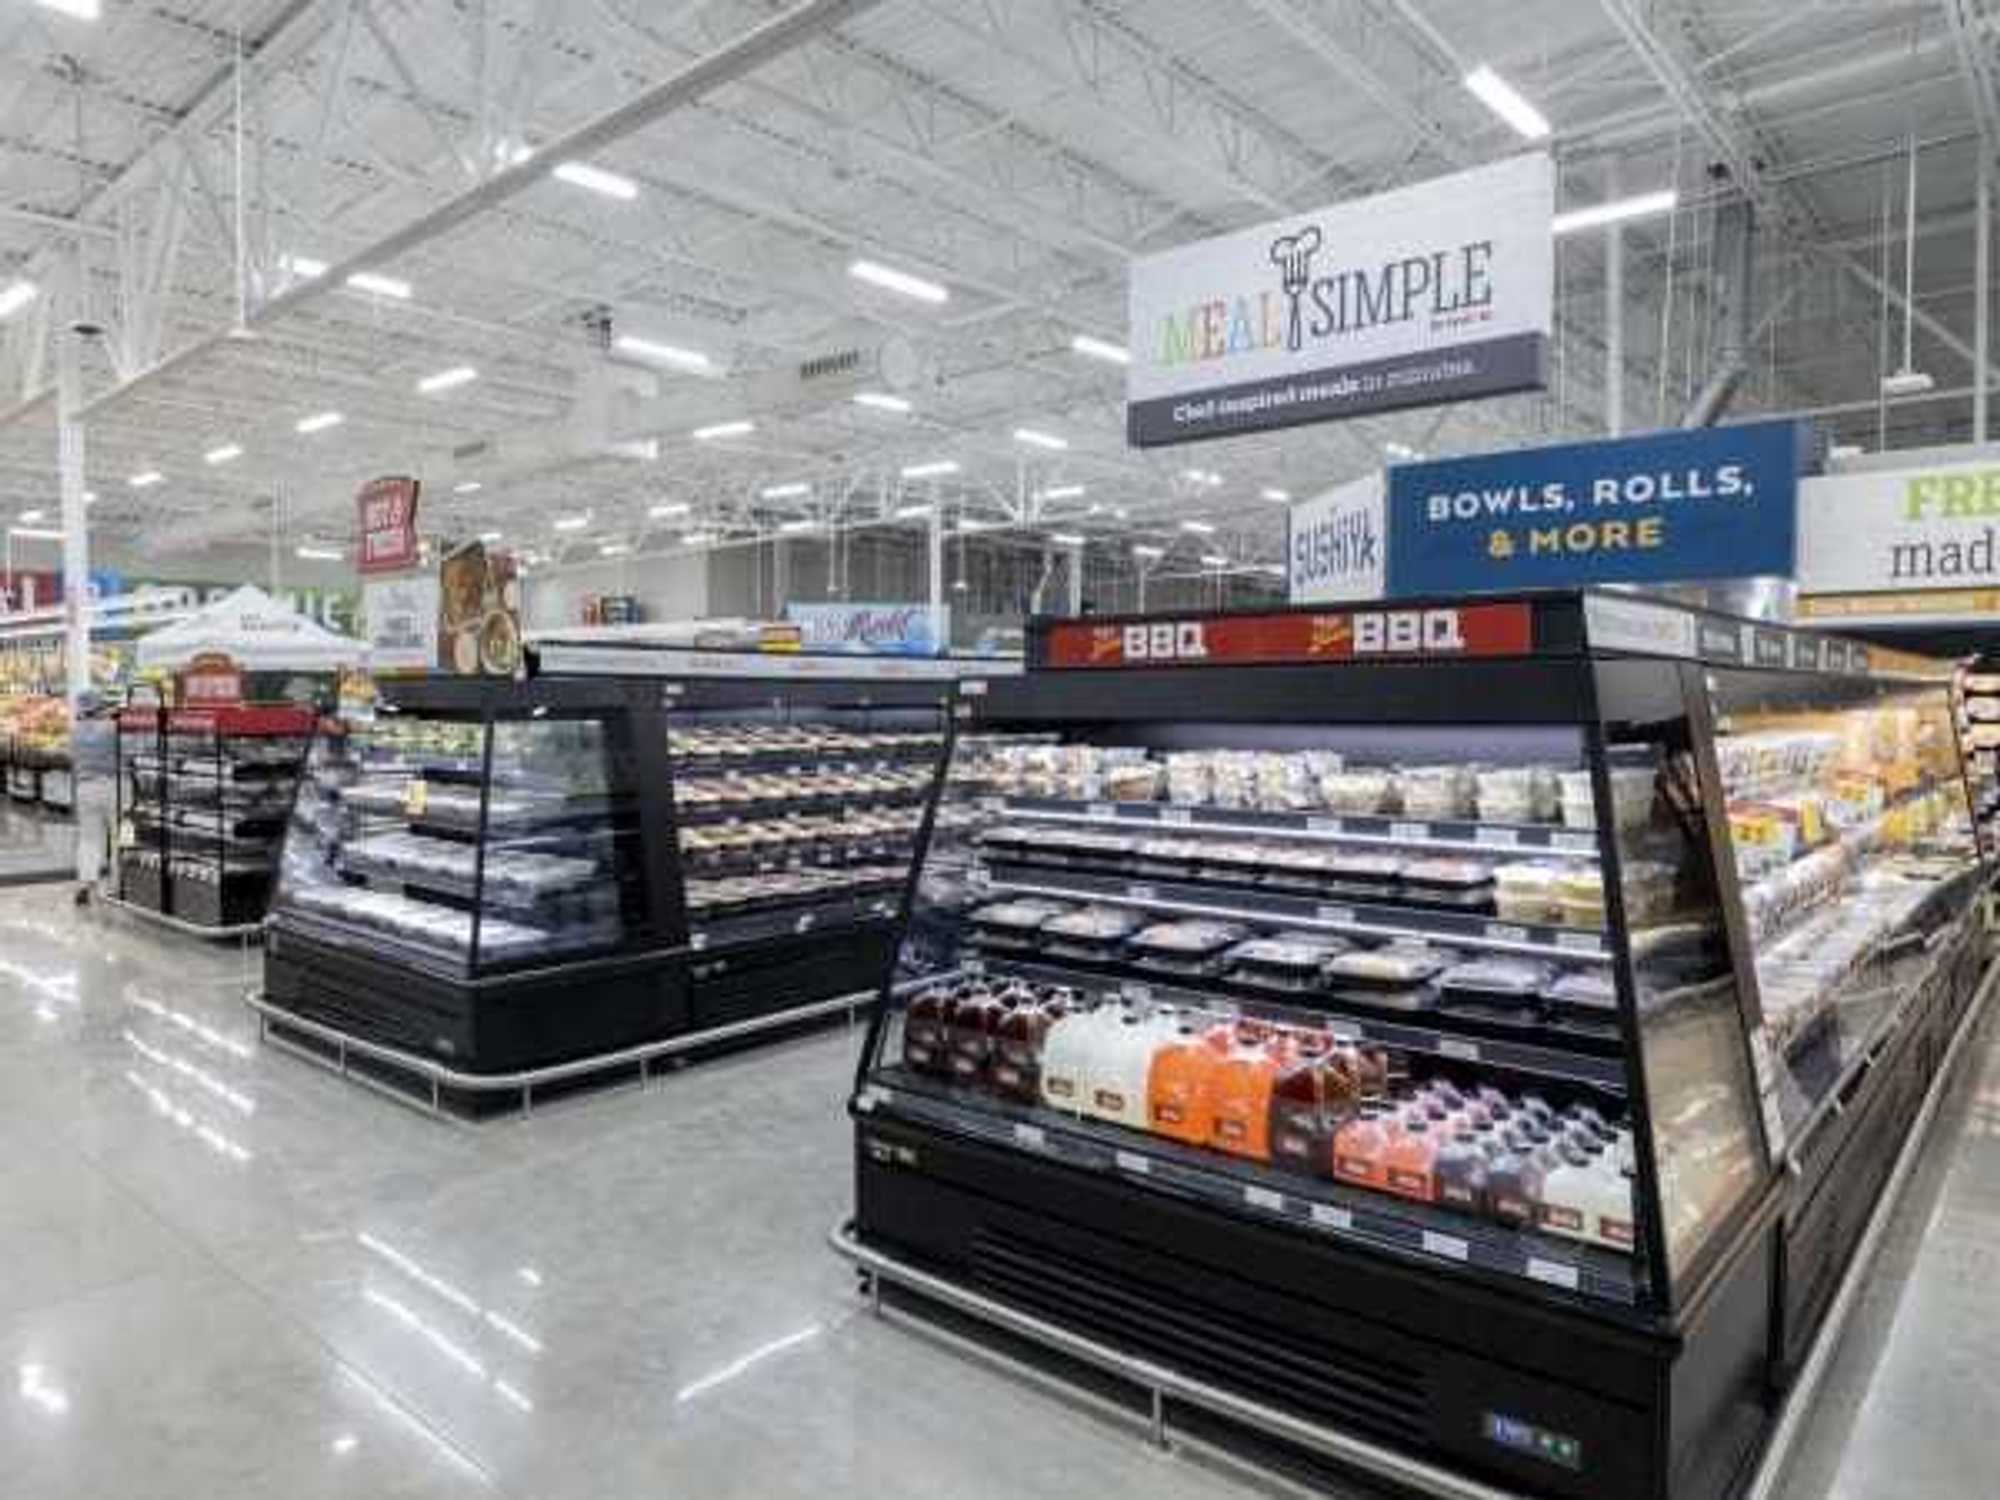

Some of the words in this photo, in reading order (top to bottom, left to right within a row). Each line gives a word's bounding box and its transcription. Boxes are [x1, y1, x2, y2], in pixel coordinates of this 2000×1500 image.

[1159, 290, 1281, 366] MEAL
[1310, 240, 1492, 338] SIMPLE
[1428, 483, 1575, 522] BOWLS,
[1593, 464, 1754, 506] ROLLS,
[1488, 529, 1514, 559] &
[1529, 517, 1664, 554] MORE
[1122, 622, 1207, 660] BBQ
[1352, 609, 1465, 652] BBQ
